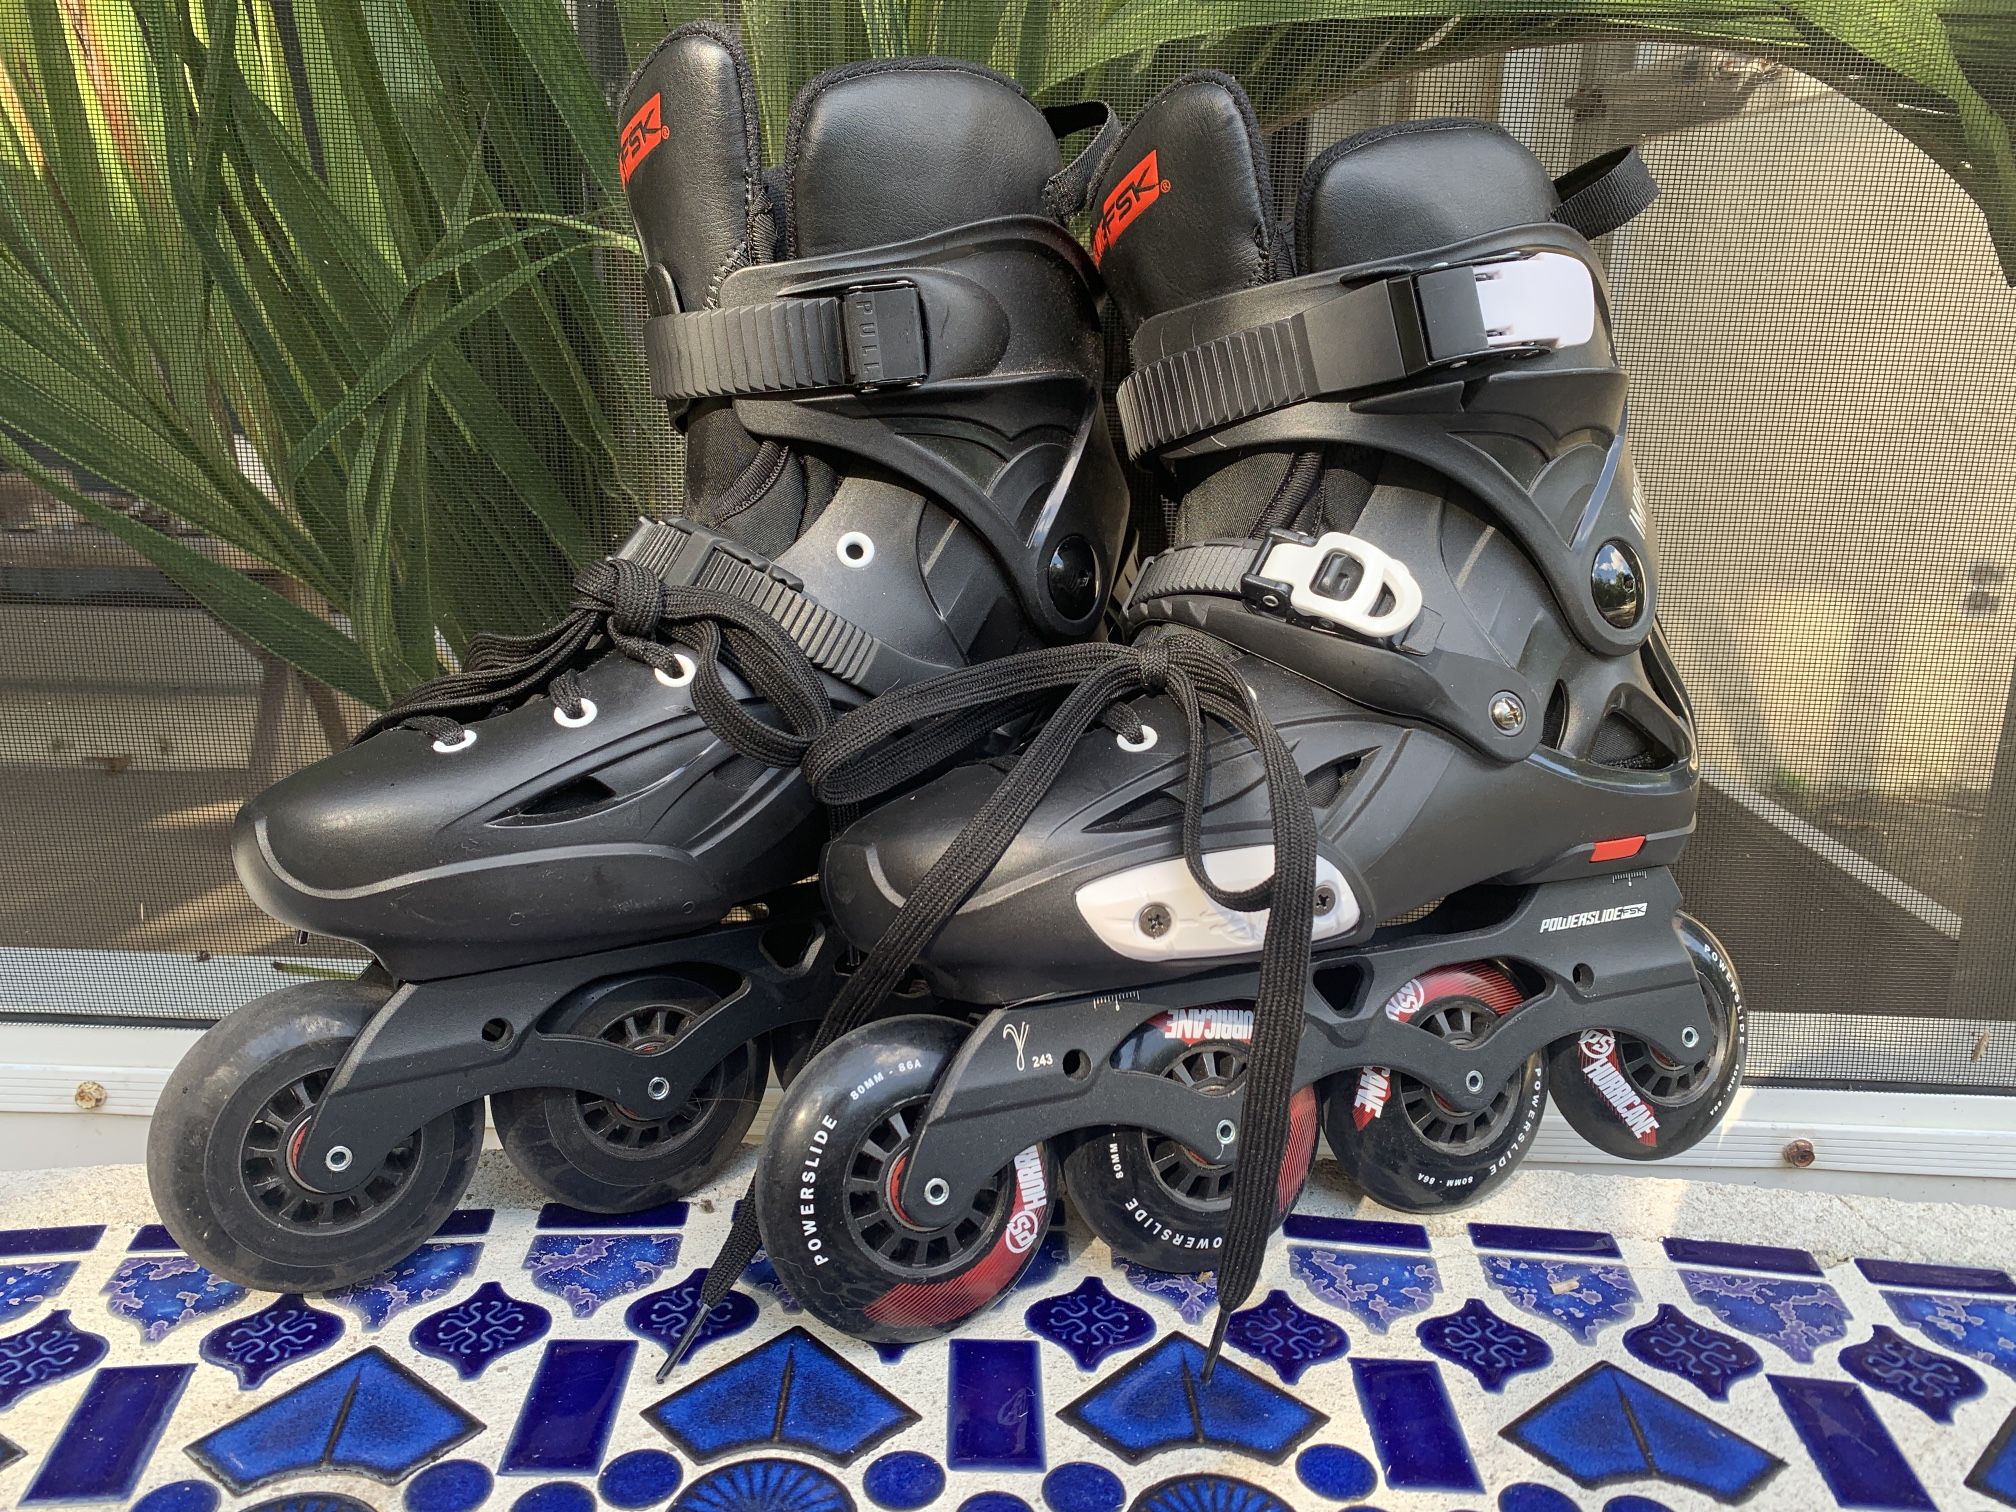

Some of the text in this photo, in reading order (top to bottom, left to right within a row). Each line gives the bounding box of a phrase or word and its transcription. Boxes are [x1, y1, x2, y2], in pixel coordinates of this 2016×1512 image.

[856, 300, 880, 375] PULL
[1539, 906, 1623, 934] POWERSLIDE
[1704, 943, 1745, 1044] POWERSLIDE
[1164, 1008, 1255, 1040] URRICANE
[851, 1072, 884, 1100] 80MM
[898, 1058, 922, 1073] 86A
[1032, 1054, 1053, 1069] 243
[1582, 1057, 1660, 1139] HURRICANE
[1490, 1067, 1542, 1176] POWERSLIDE
[1109, 1143, 1124, 1179] 80MM
[1417, 1172, 1436, 1185] 86A
[1446, 1175, 1474, 1187] 80MM
[800, 1114, 838, 1266] POWERSLIDE
[1125, 1197, 1223, 1249] OWERSLIDE
